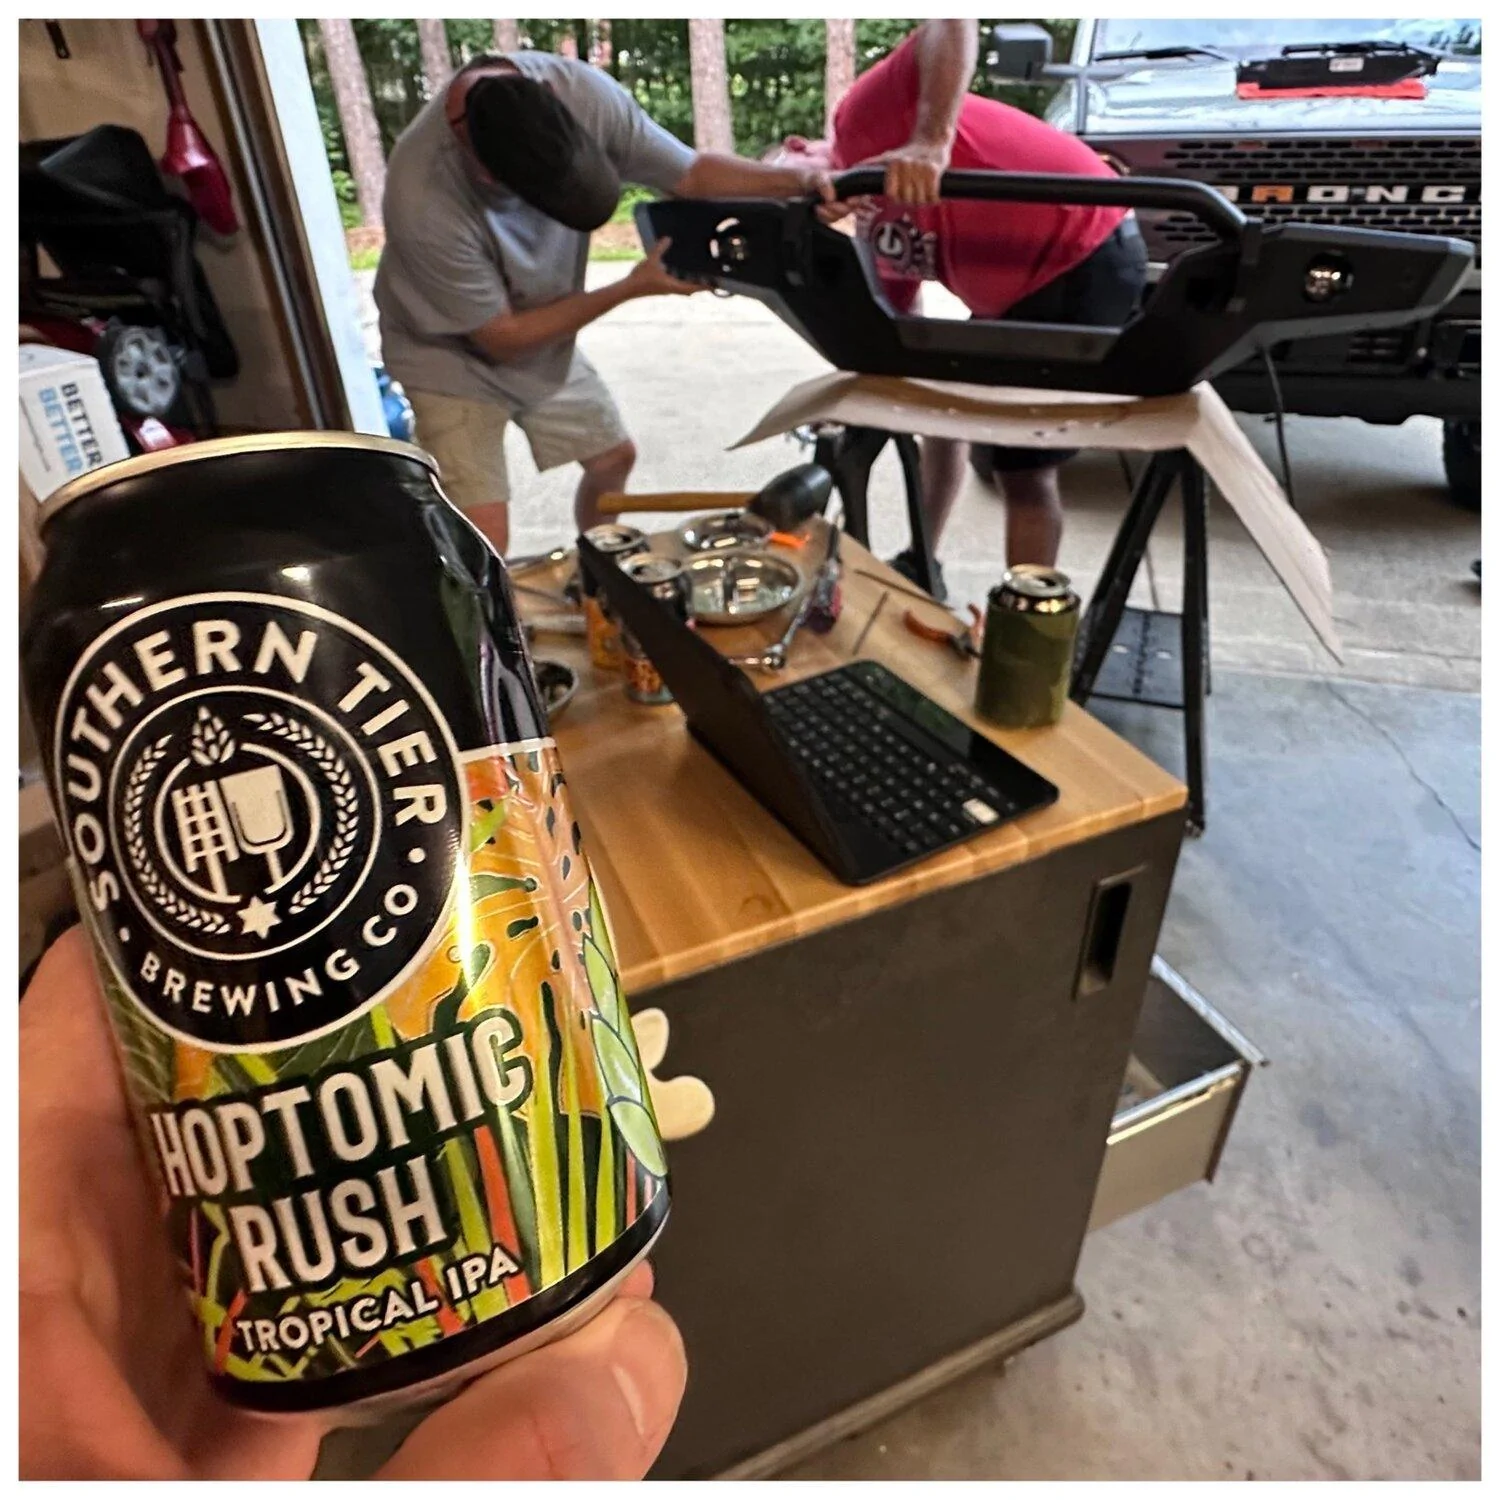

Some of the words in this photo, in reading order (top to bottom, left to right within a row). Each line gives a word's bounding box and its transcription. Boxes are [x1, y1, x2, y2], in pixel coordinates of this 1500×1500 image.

[1211, 185, 1481, 203] RONC
[38, 387, 83, 475] BETTER
[61, 381, 102, 466] BETTER
[67, 619, 319, 912] SOUTHERN
[337, 662, 448, 827] TIER
[139, 947, 361, 1018] BREWING
[362, 882, 419, 948] CO
[150, 1014, 527, 1197] HOPTOMIC
[229, 1153, 448, 1294] RUSH
[236, 1279, 440, 1354] TROPICAL
[445, 1246, 520, 1300] IPA
